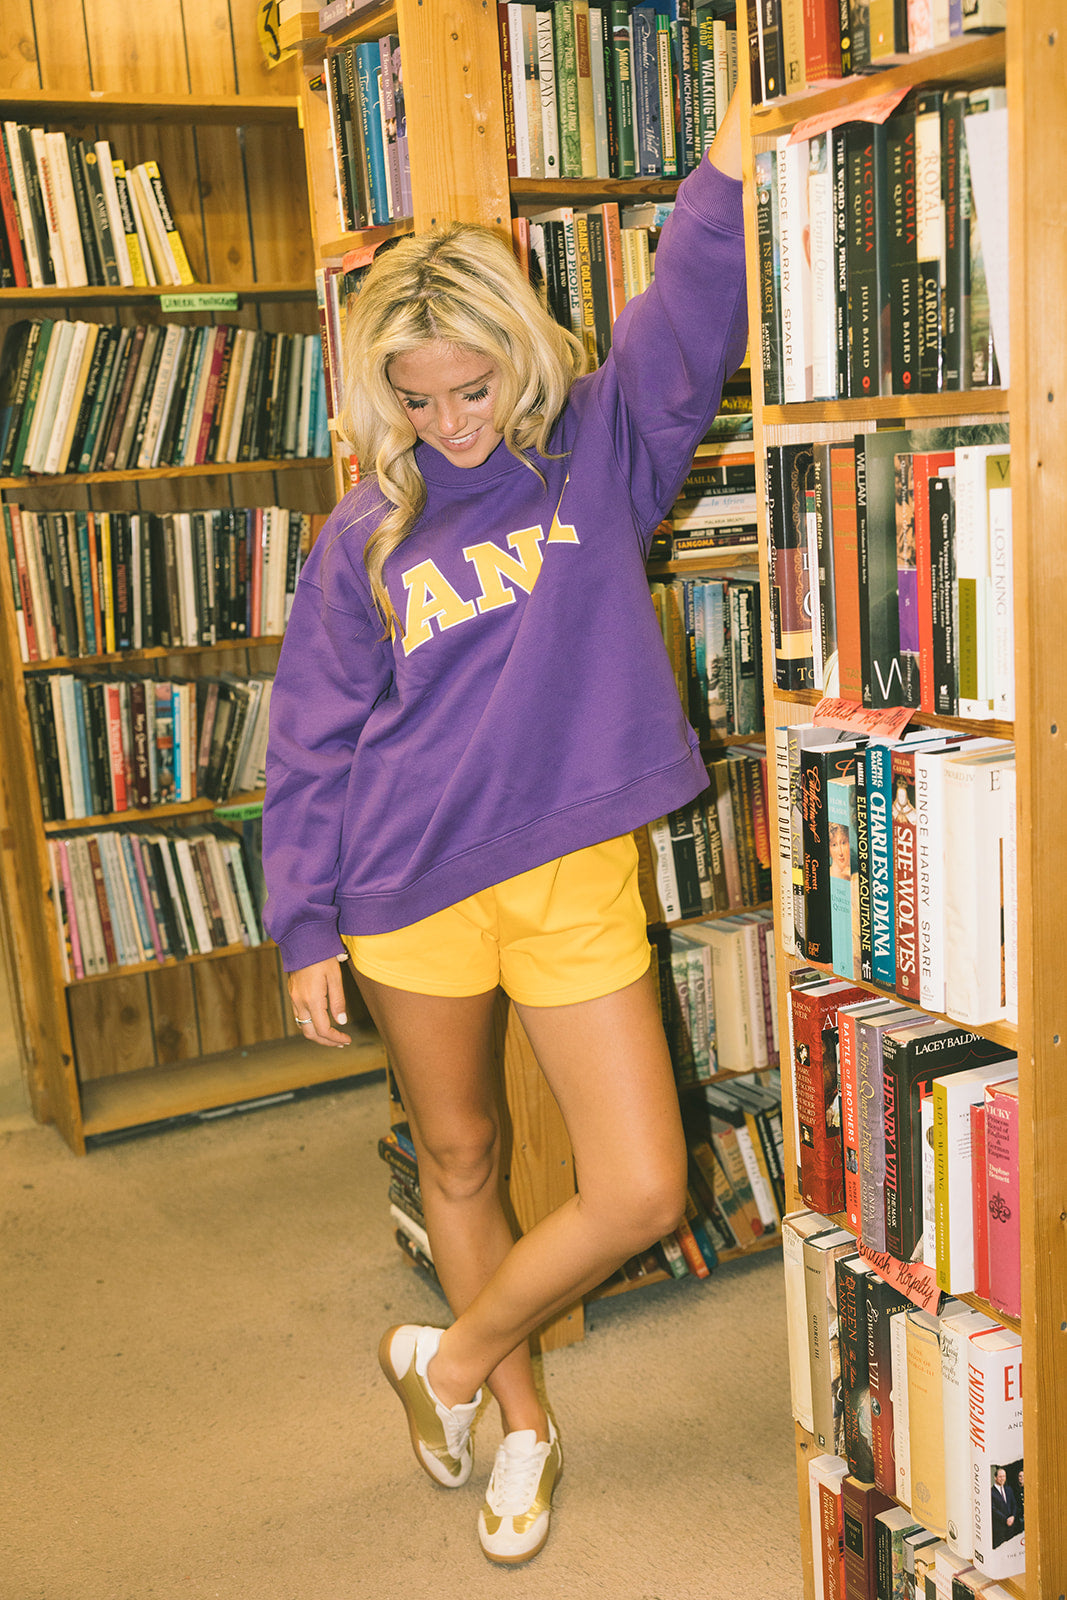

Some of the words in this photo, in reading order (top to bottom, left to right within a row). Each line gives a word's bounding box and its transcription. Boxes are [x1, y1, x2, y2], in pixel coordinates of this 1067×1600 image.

[563, 5, 572, 32] CAMPING
[382, 52, 391, 78] Born
[565, 47, 574, 69] PRINCE
[615, 47, 630, 81] SANGOMA
[682, 26, 690, 71] SAHARA
[719, 50, 727, 71] NILE
[346, 49, 355, 102] DAUGHTERS
[540, 70, 554, 108] DAYS
[684, 73, 692, 116] MICHAEL
[702, 59, 715, 115] WALKING
[385, 90, 393, 111] Rule
[568, 111, 576, 131] AFRICA
[685, 117, 693, 144] PALIN
[706, 116, 714, 129] THE
[152, 180, 174, 231] Photography
[779, 150, 788, 220] PRINCE
[815, 183, 826, 203] The
[864, 145, 873, 252] VICTORIA
[905, 133, 914, 244] VICTORIA
[924, 150, 939, 227] ROYAL
[116, 180, 134, 233] Photography
[838, 213, 845, 231] OF
[894, 184, 902, 237] QUEEN
[565, 223, 576, 256] WILD
[577, 220, 589, 253] GRAINS
[763, 241, 771, 257] IN
[839, 235, 845, 243] A
[781, 230, 790, 292] HARRY
[815, 259, 827, 302] Queen
[567, 260, 579, 309] PEOPLE
[578, 265, 592, 300] GOLDEN
[764, 261, 773, 313] SEARCH
[901, 278, 910, 316] JULIA
[583, 302, 595, 326] SAND
[861, 286, 869, 322] JULIA
[926, 279, 938, 350] CAROLLY
[784, 308, 792, 366] SPARE
[857, 452, 866, 506] WILLIAM
[677, 538, 715, 549] SANGOMA
[941, 514, 949, 538] QUEEN
[391, 472, 580, 657] AN
[995, 528, 1005, 570] LOST
[739, 593, 750, 629] Bernhard
[995, 576, 1007, 615] KING
[135, 733, 145, 754] Queen
[777, 746, 787, 768] THE
[789, 739, 800, 805] William
[777, 776, 789, 811] LAST
[807, 766, 822, 823] Catherine
[919, 769, 929, 836] PRINCE
[779, 818, 790, 859] QUEEN
[857, 796, 868, 859] ELEANOR
[870, 792, 888, 880] CHARLES
[695, 836, 706, 878] Wilderness
[710, 833, 721, 875] Wilderness
[793, 832, 801, 869] Kate
[873, 880, 889, 897] &
[920, 846, 930, 907] HARRY
[860, 875, 871, 951] AQUITAINE
[897, 826, 915, 974] SHE-WOLVES
[873, 897, 890, 957] DIANA
[922, 921, 931, 978] SPARE
[843, 1022, 851, 1065] BATTLE
[860, 1052, 869, 1077] First
[915, 1039, 947, 1056] LACEY
[846, 1083, 855, 1143] BROTHERS
[860, 1080, 874, 1119] Queen
[883, 1072, 896, 1149] HENRY
[985, 1104, 1011, 1120] VICKY
[861, 1130, 873, 1174] England
[885, 1153, 897, 1192] VIII
[839, 1275, 847, 1328] ANNE
[896, 1262, 934, 1309] Royalty
[845, 1275, 857, 1342] QUEEN
[866, 1299, 879, 1357] EDWARD
[868, 1361, 879, 1391] VII
[968, 1362, 985, 1452] ENDGAME
